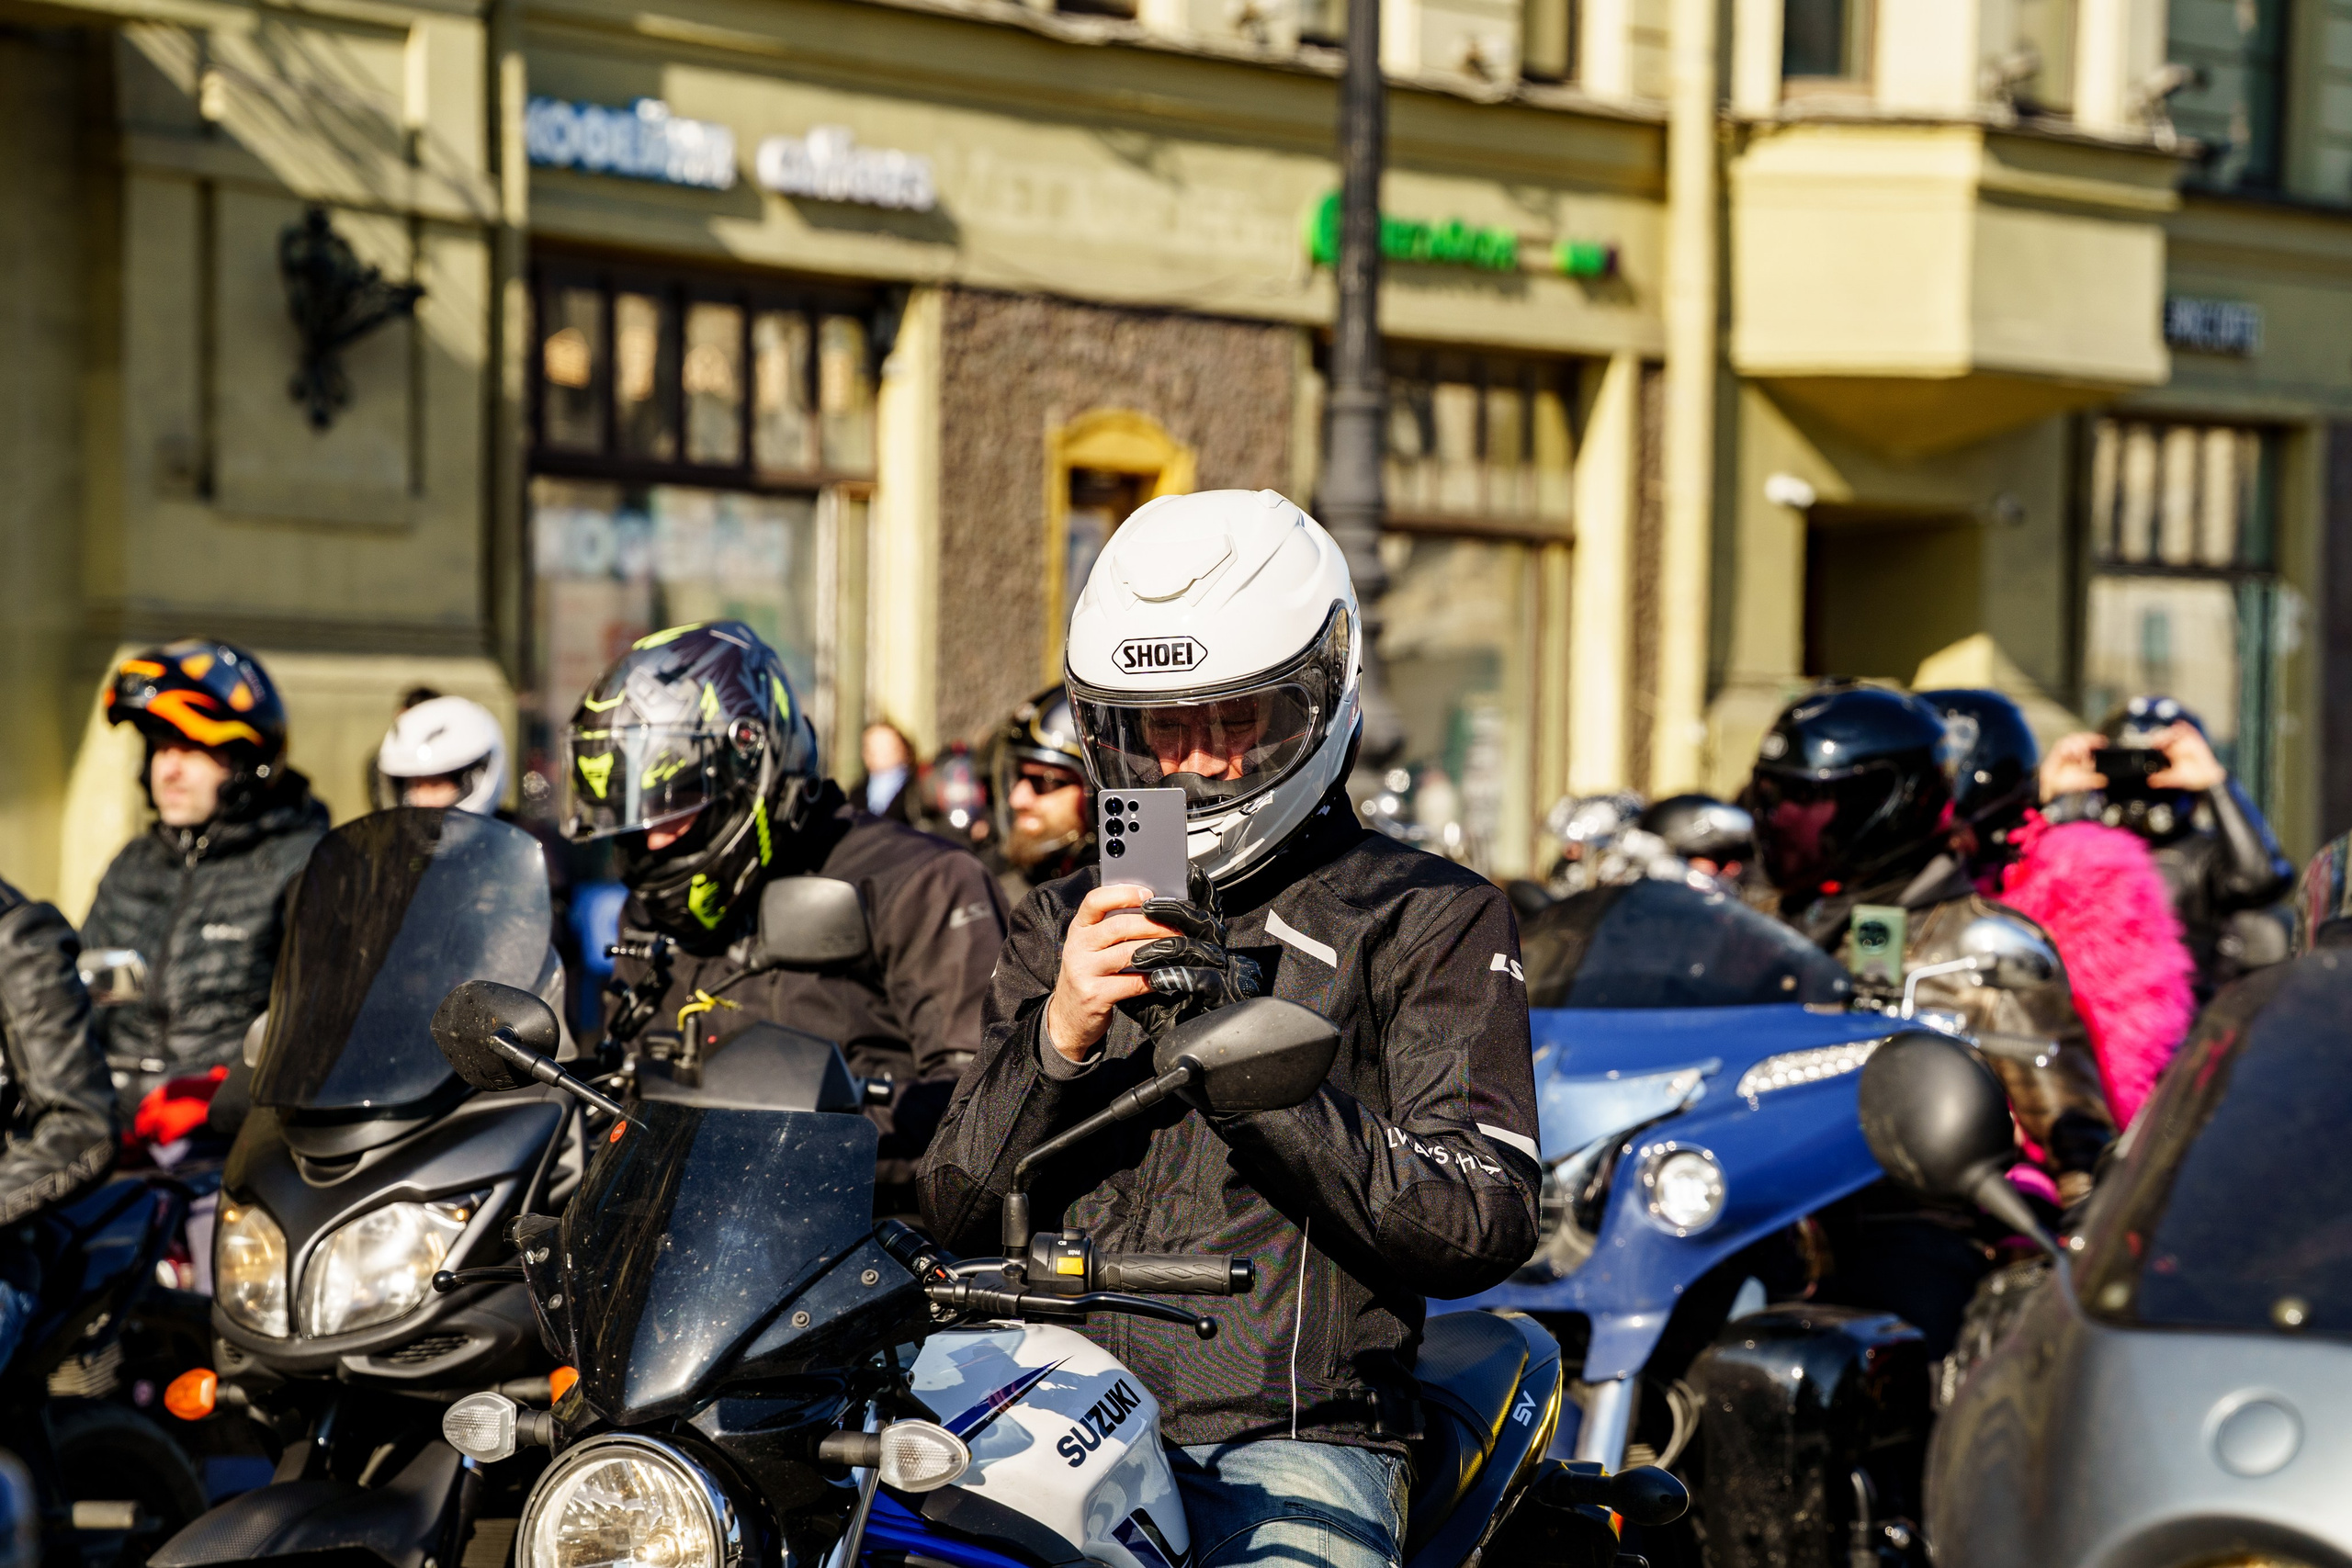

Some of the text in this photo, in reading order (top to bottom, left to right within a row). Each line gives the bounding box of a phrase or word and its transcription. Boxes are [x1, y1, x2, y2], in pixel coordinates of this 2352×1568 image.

[1123, 642, 1193, 669] SHOEI
[1057, 1378, 1141, 1468] SUZUKI
[1512, 1390, 1537, 1427] SV
